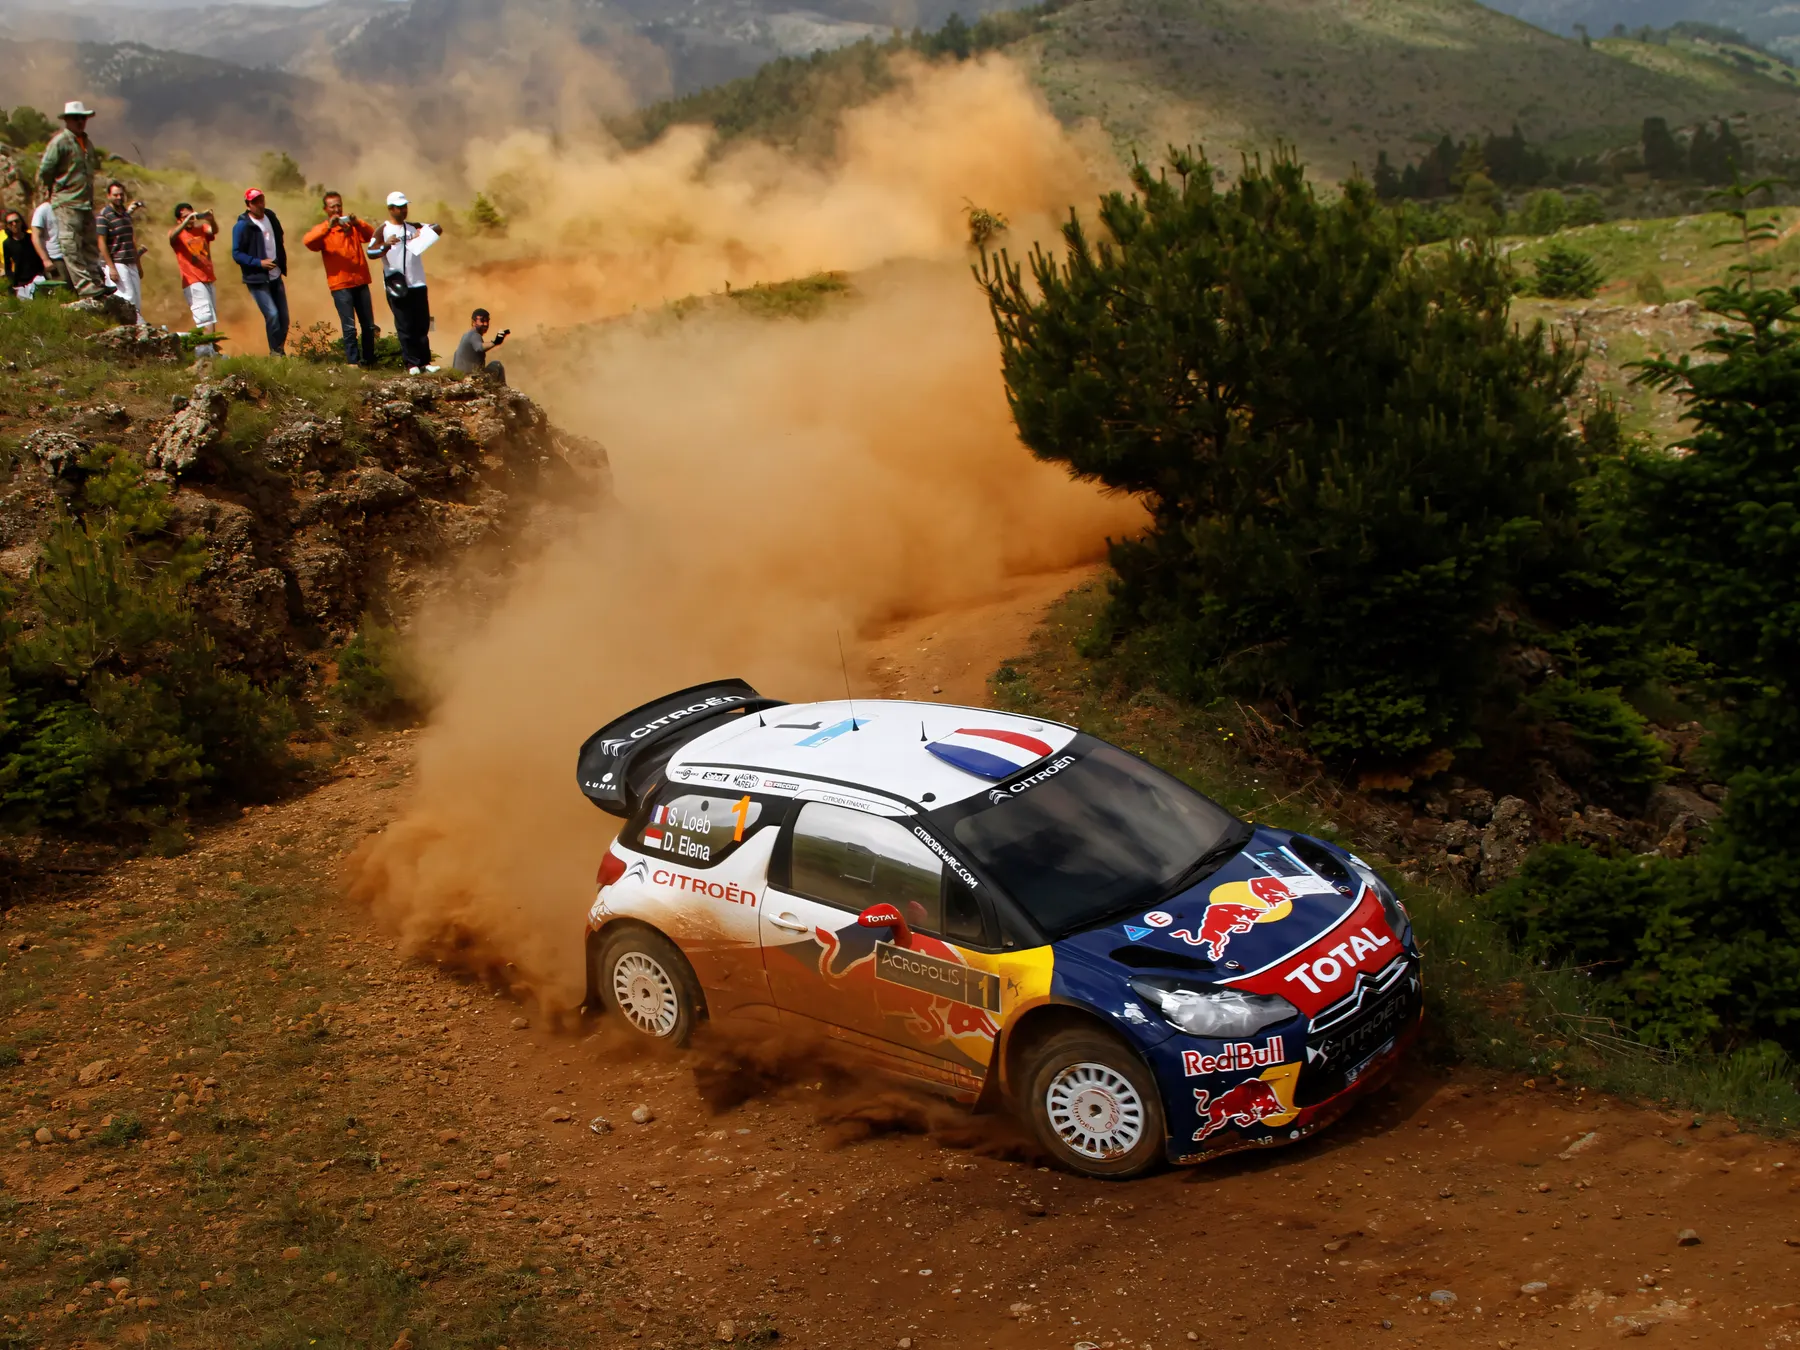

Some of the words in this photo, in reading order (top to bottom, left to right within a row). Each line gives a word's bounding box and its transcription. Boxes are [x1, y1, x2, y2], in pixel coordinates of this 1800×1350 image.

[630, 695, 747, 739] CITROËN
[585, 780, 617, 791] LUHTA
[1009, 755, 1076, 792] CITROËN
[668, 807, 678, 827] S.
[682, 809, 711, 834] Loeb
[731, 795, 751, 842] 1
[664, 832, 675, 852] D.
[678, 836, 711, 861] Elena
[653, 870, 757, 907] CITROËN
[864, 913, 897, 923] TOTAL
[1148, 913, 1169, 926] E
[881, 951, 960, 986] ACROPOLIS
[1284, 927, 1391, 994] TOTAL
[978, 975, 989, 1008] 1
